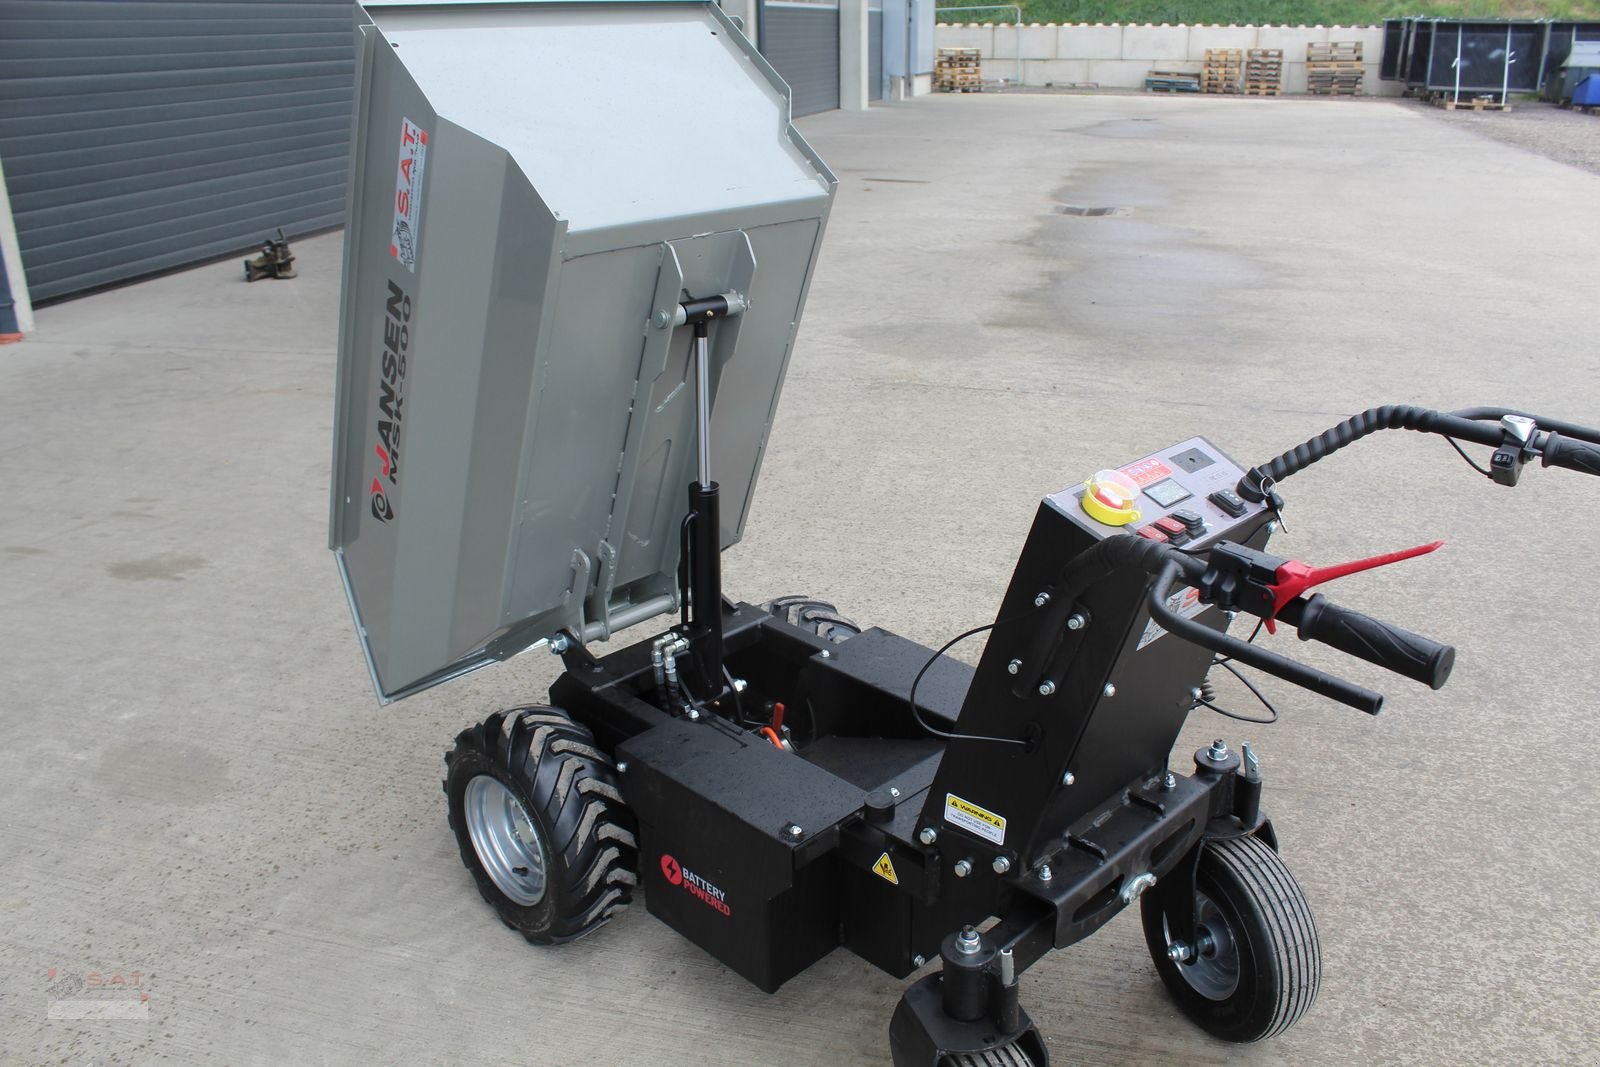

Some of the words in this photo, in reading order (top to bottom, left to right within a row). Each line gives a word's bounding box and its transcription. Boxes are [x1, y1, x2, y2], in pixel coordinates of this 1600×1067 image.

[376, 279, 404, 476] JANSEN
[389, 295, 411, 485] MSK-500
[960, 804, 992, 822] WARNING
[682, 867, 725, 902] BATTERY
[683, 879, 731, 916] POWERED
